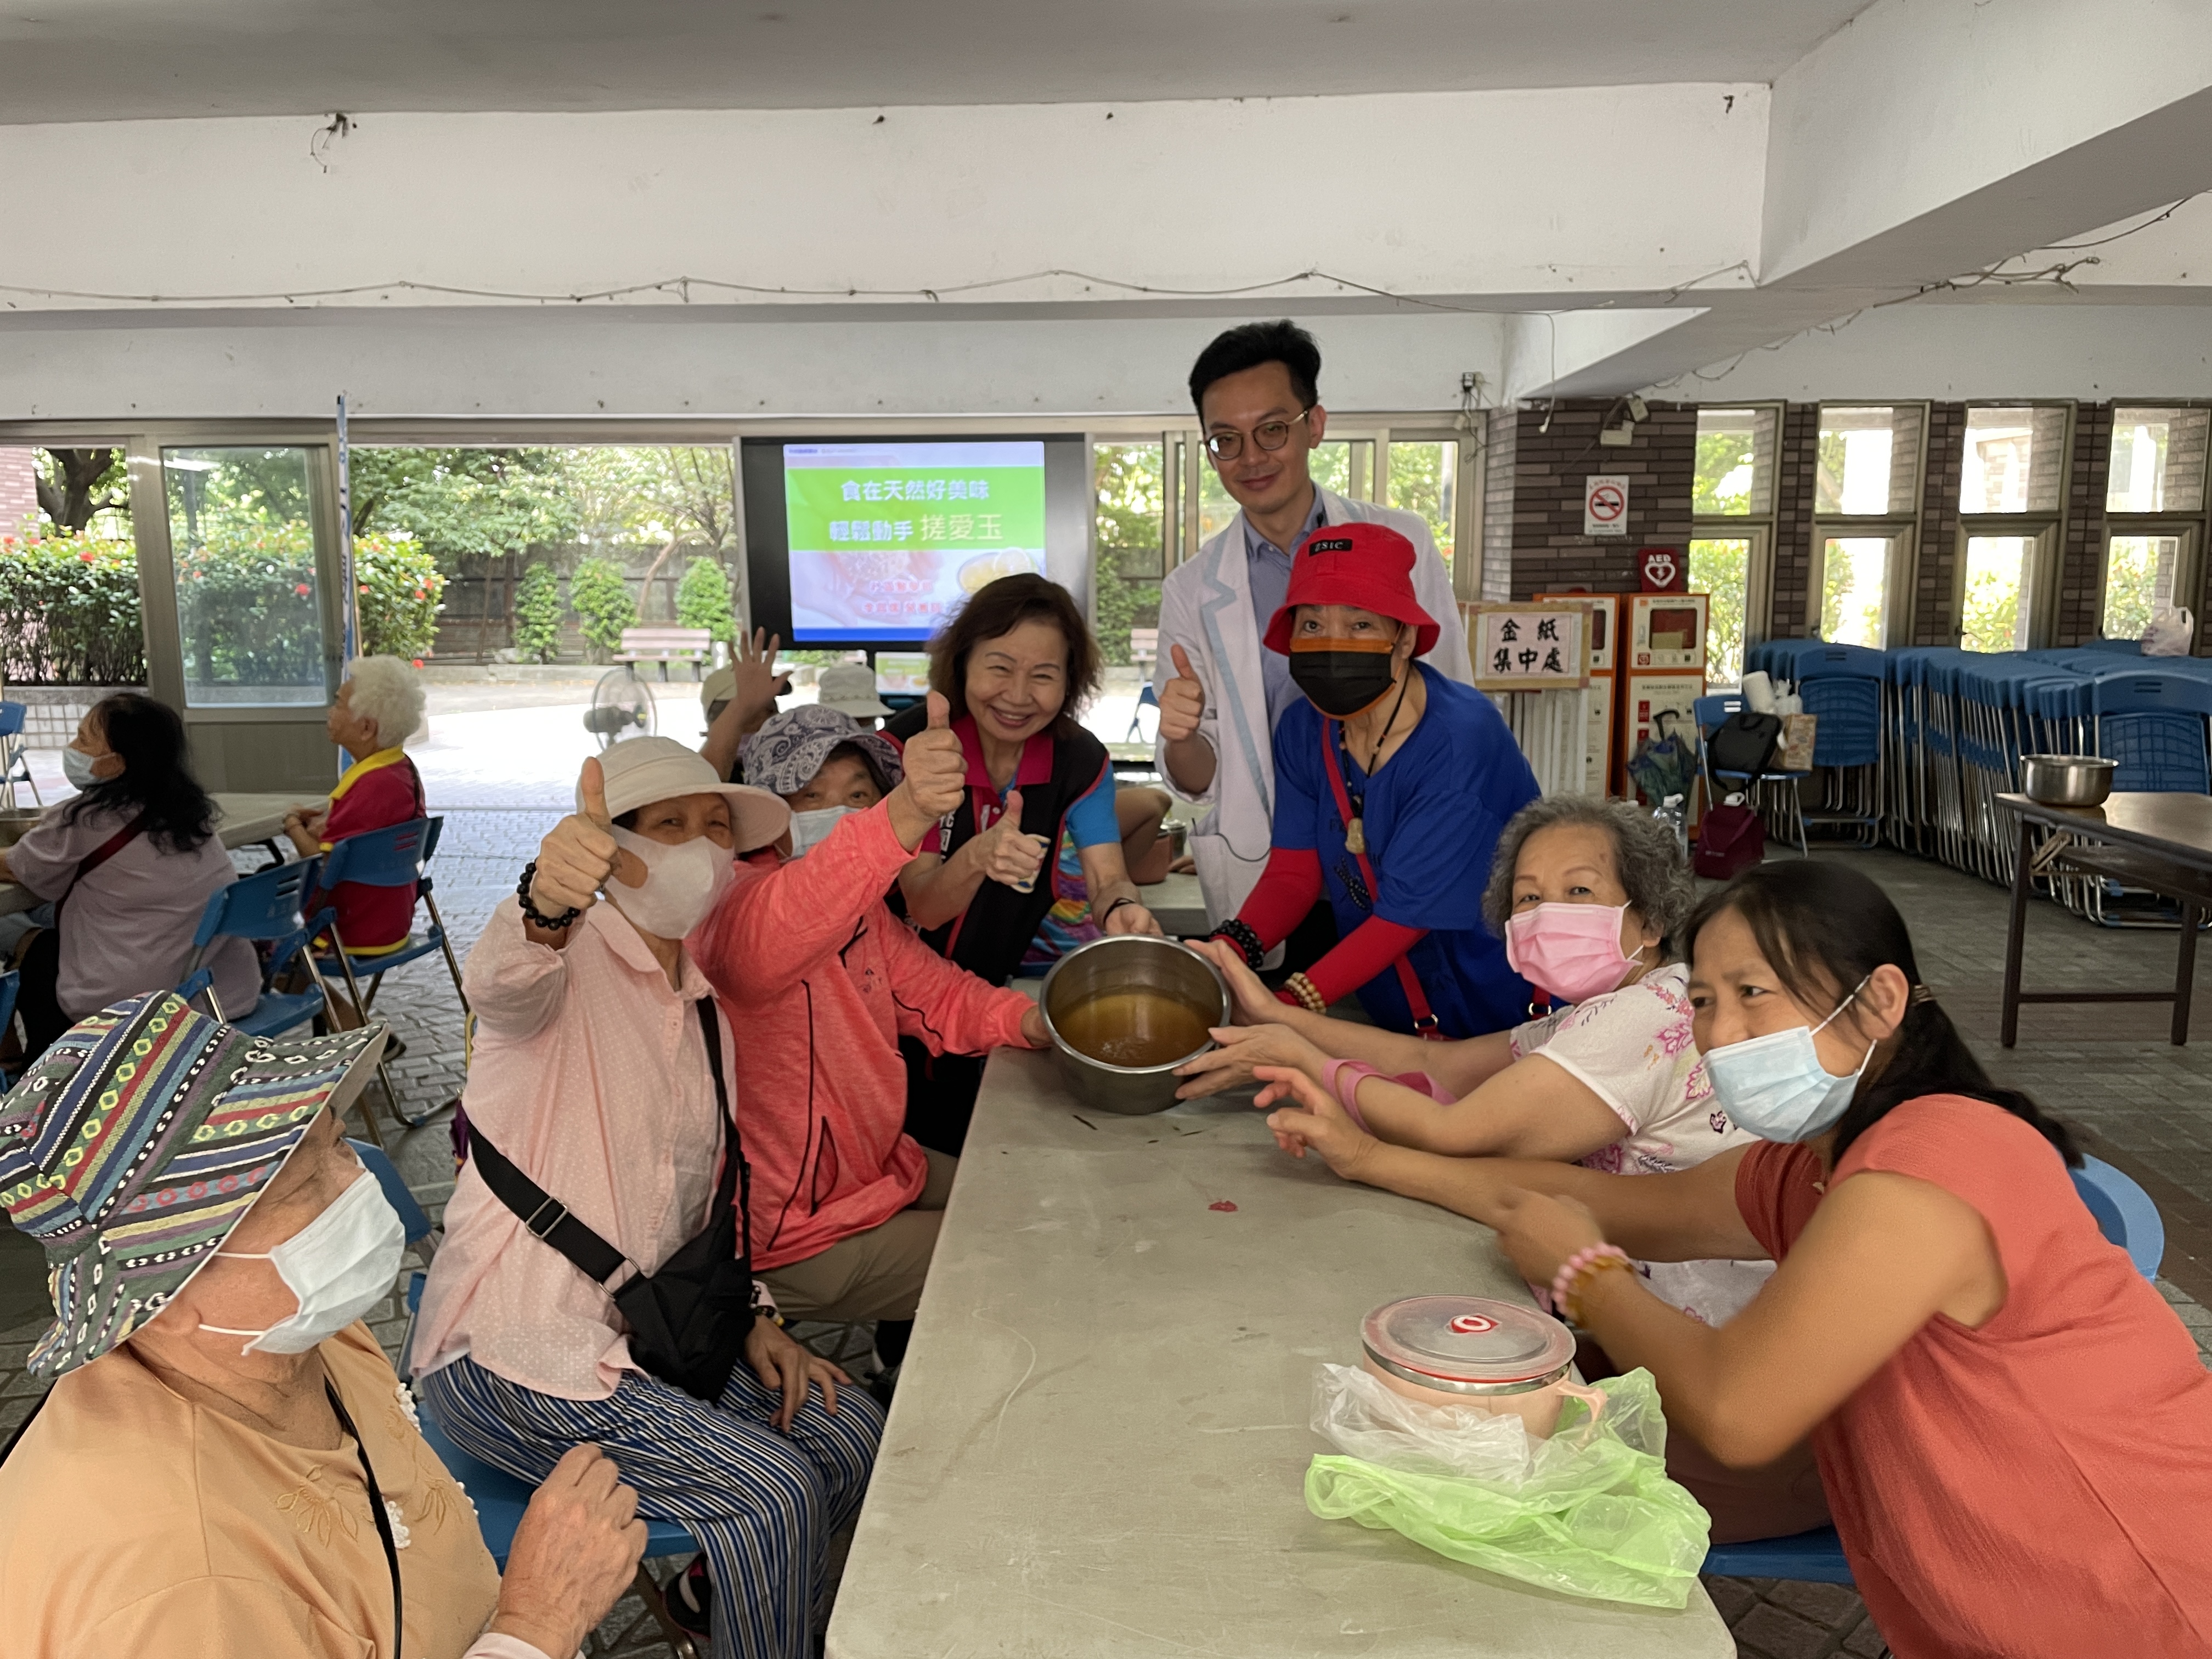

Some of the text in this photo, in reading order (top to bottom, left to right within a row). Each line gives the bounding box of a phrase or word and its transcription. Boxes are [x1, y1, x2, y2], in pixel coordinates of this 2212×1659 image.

[841, 479, 990, 501] 食在天然好美味
[920, 514, 1003, 541] 搓愛玉
[1648, 554, 1672, 562] AED
[1493, 646, 1564, 674] 集中處
